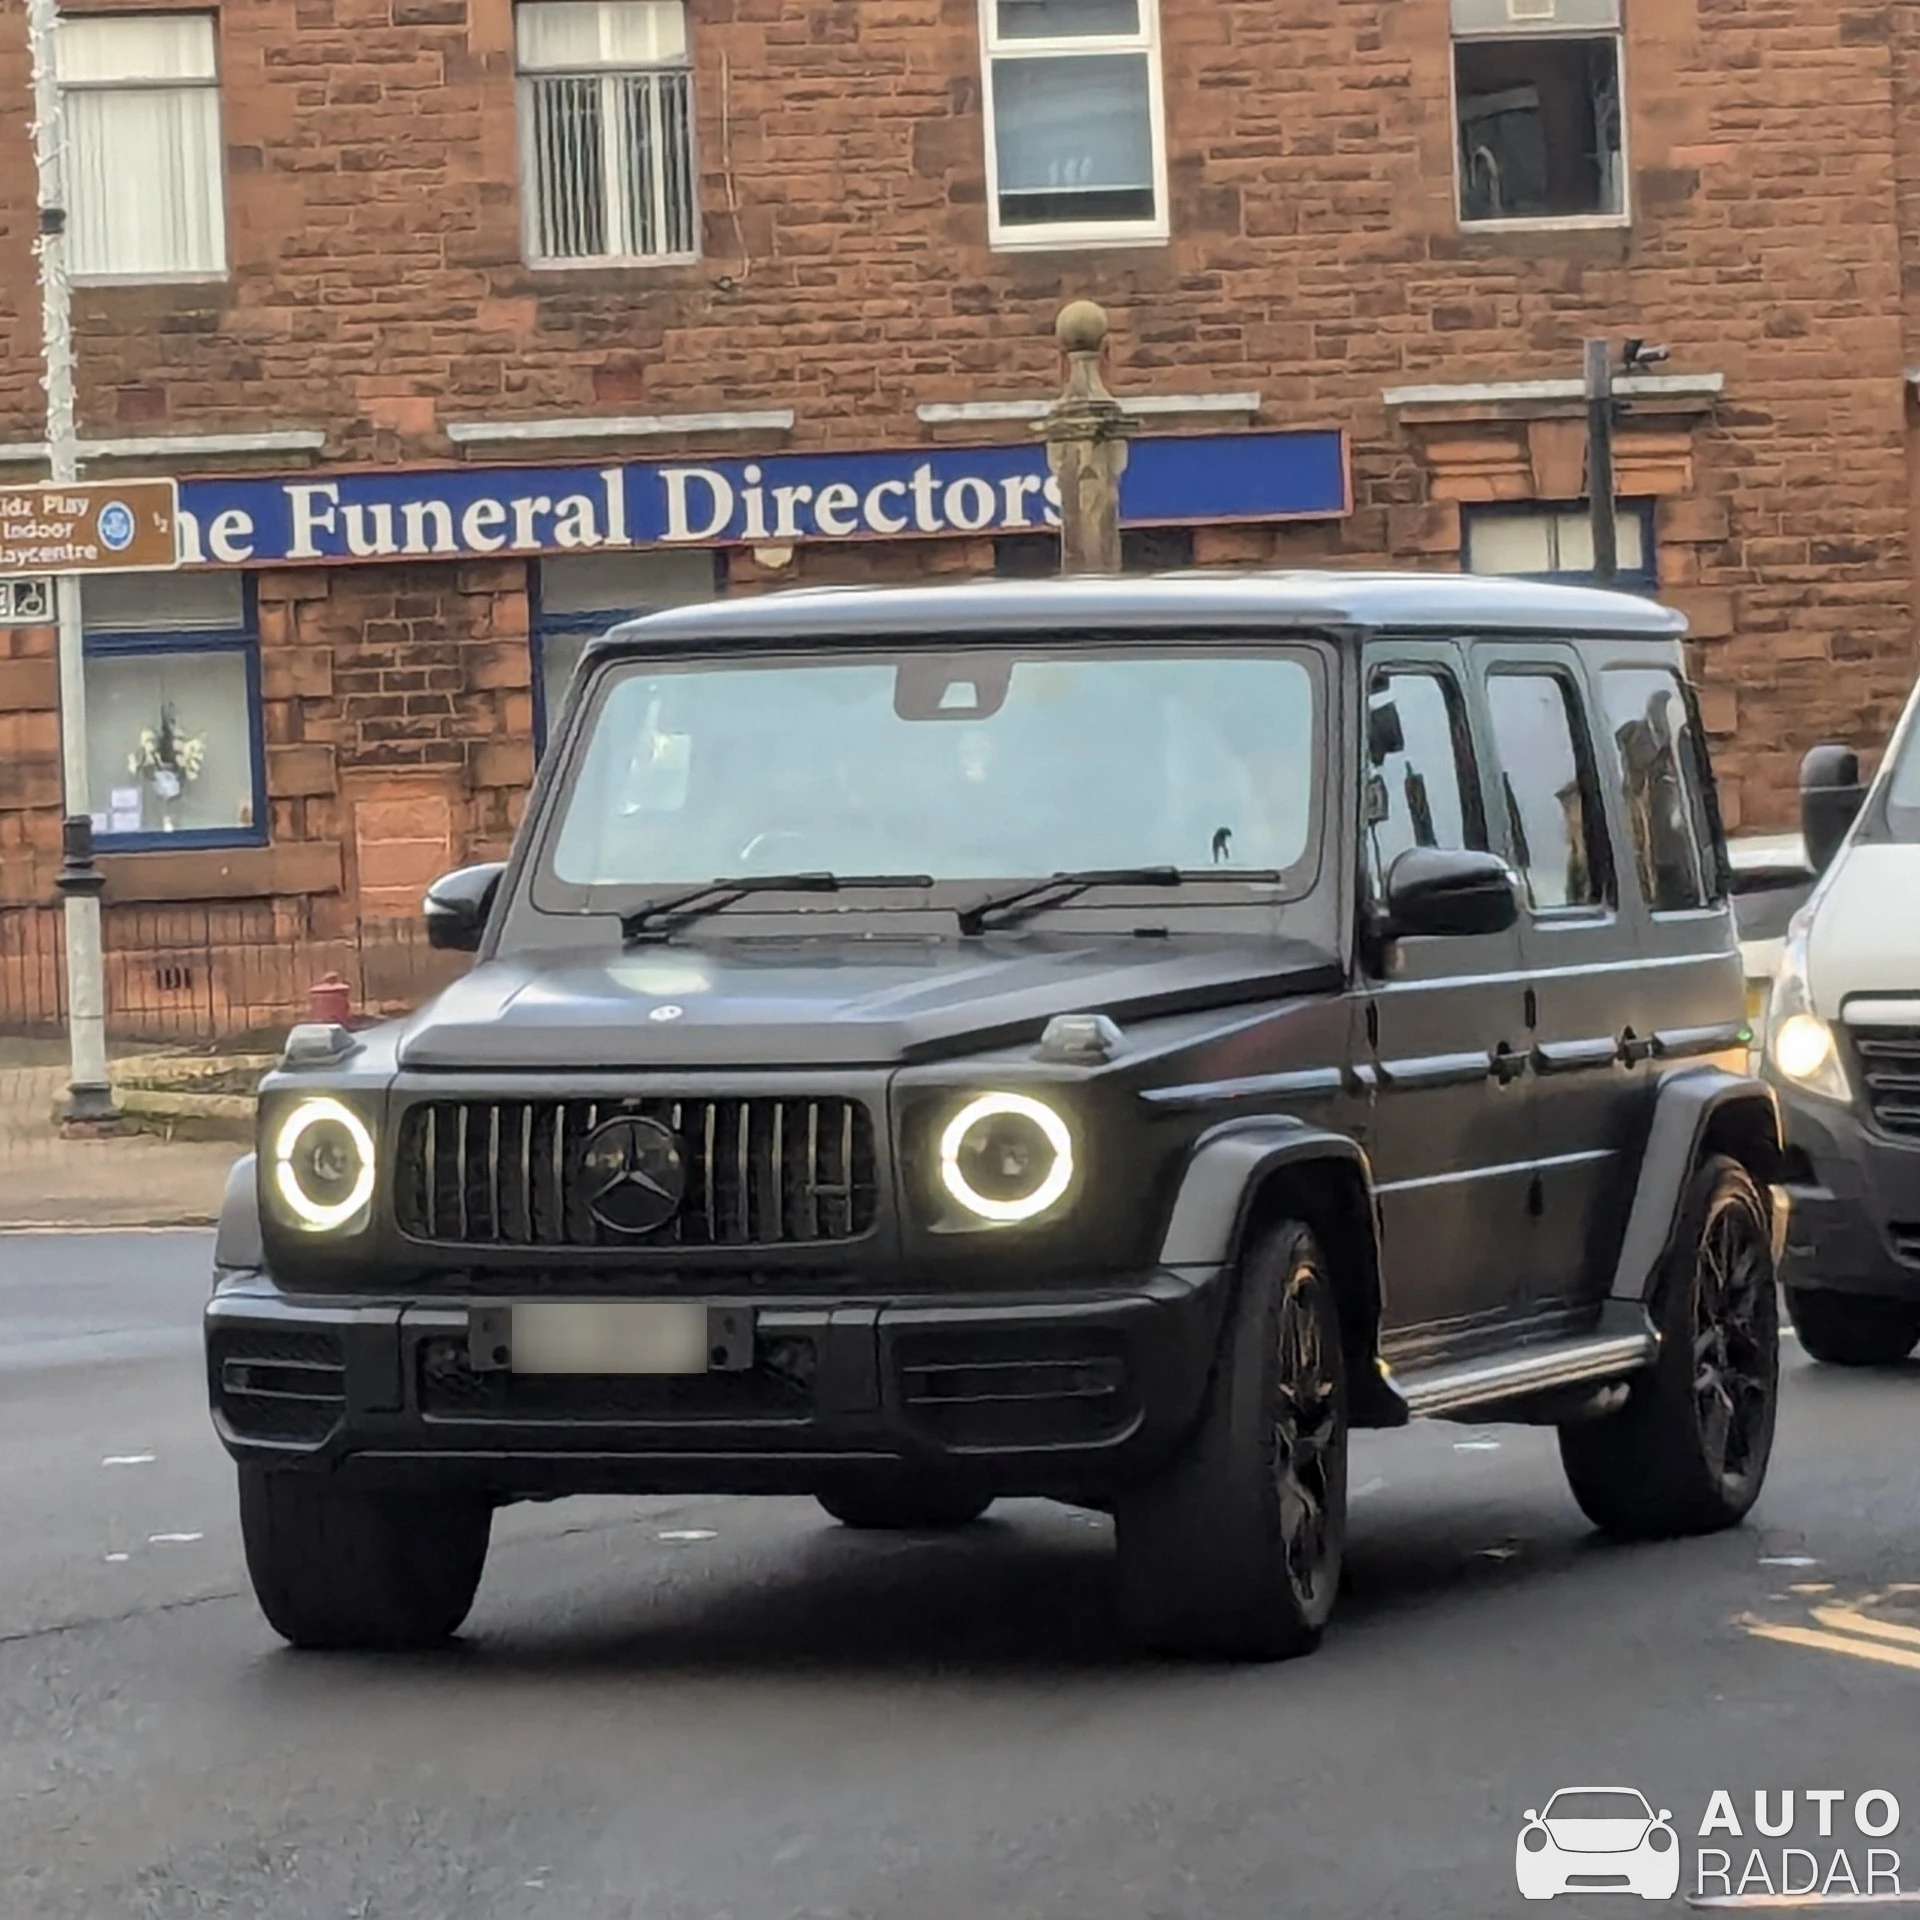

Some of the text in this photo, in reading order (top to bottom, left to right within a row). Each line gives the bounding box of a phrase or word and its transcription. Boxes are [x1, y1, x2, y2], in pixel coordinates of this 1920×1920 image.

[0, 495, 89, 517] idz Play
[283, 467, 632, 558] Funeral
